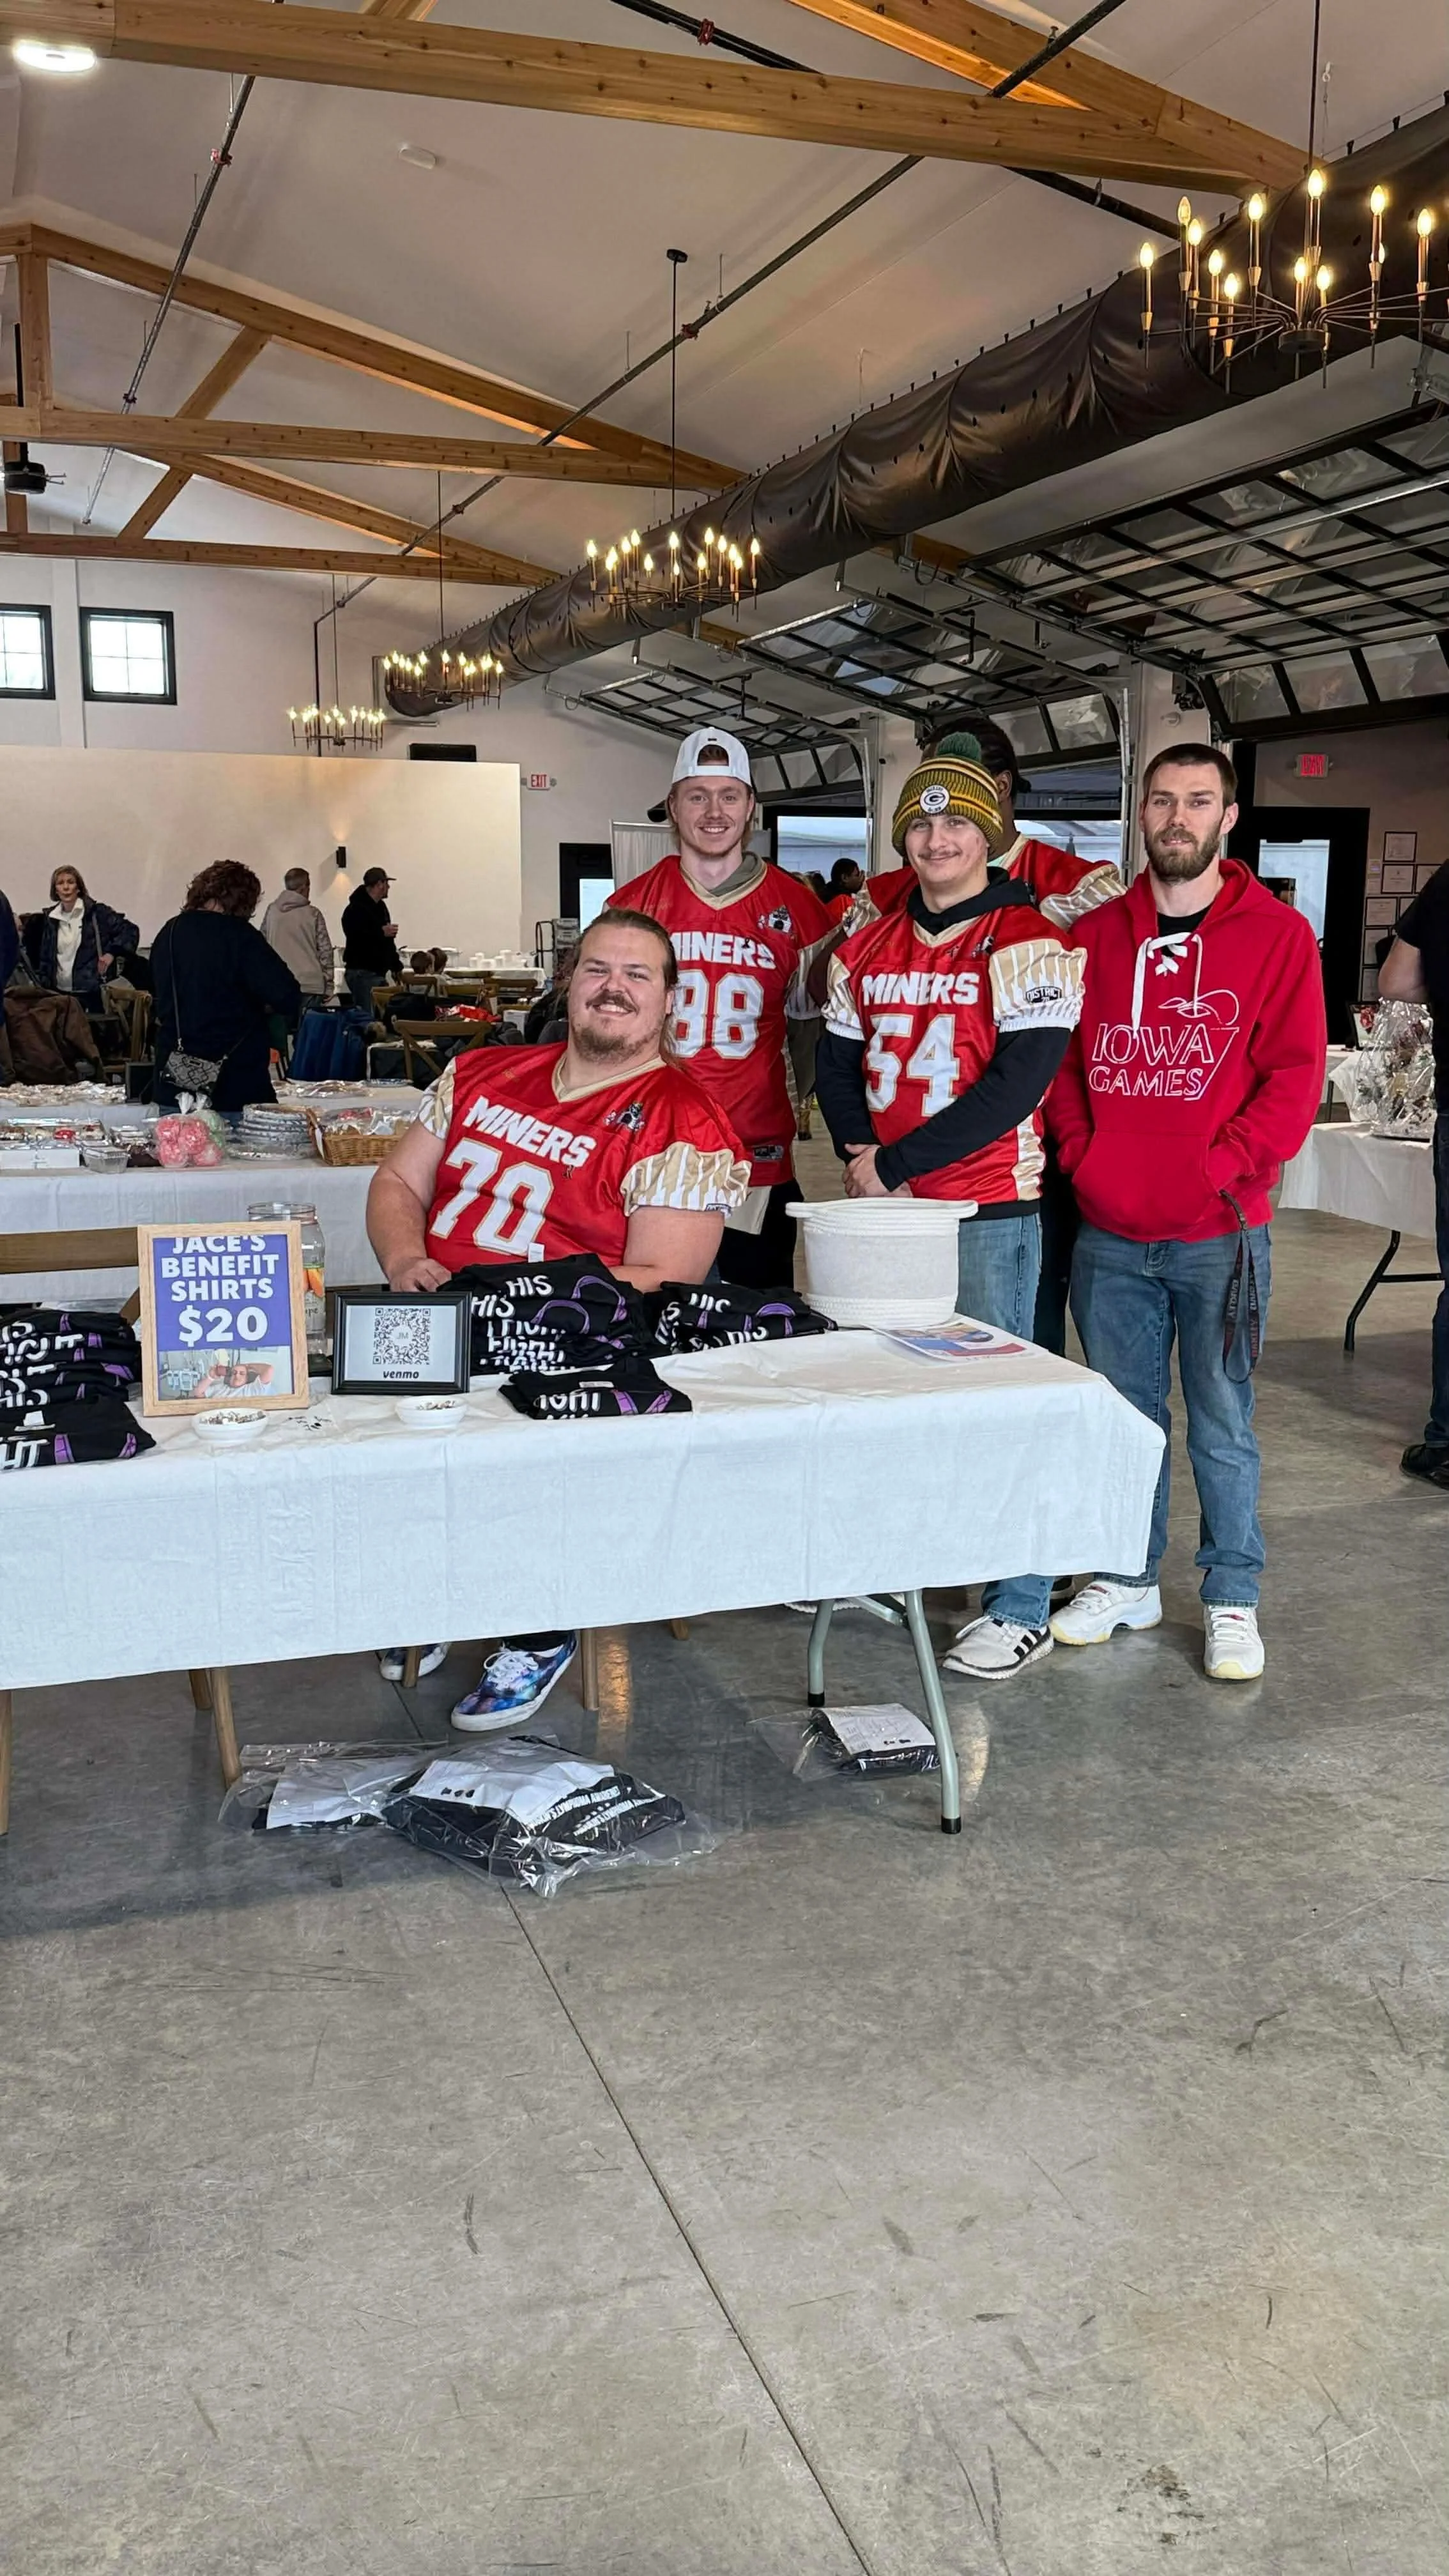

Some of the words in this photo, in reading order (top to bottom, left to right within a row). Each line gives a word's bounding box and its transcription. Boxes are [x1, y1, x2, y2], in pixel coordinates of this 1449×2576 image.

[531, 774, 548, 788] EXIT
[862, 970, 980, 1006] MINERS
[1027, 987, 1061, 1002] DISTRICT
[672, 969, 765, 1060] 88
[1091, 1023, 1215, 1066] IOWA
[865, 1013, 961, 1117] 54
[1088, 1065, 1204, 1097] GAMES
[462, 1094, 597, 1168] MINERS
[429, 1136, 555, 1257] 70
[172, 1235, 266, 1255] JACE'S
[161, 1254, 279, 1278] BENEFIT
[171, 1277, 274, 1303] SHIRTS
[505, 1275, 553, 1298] HIS
[178, 1305, 268, 1348] $20
[383, 1370, 420, 1379] venmo
